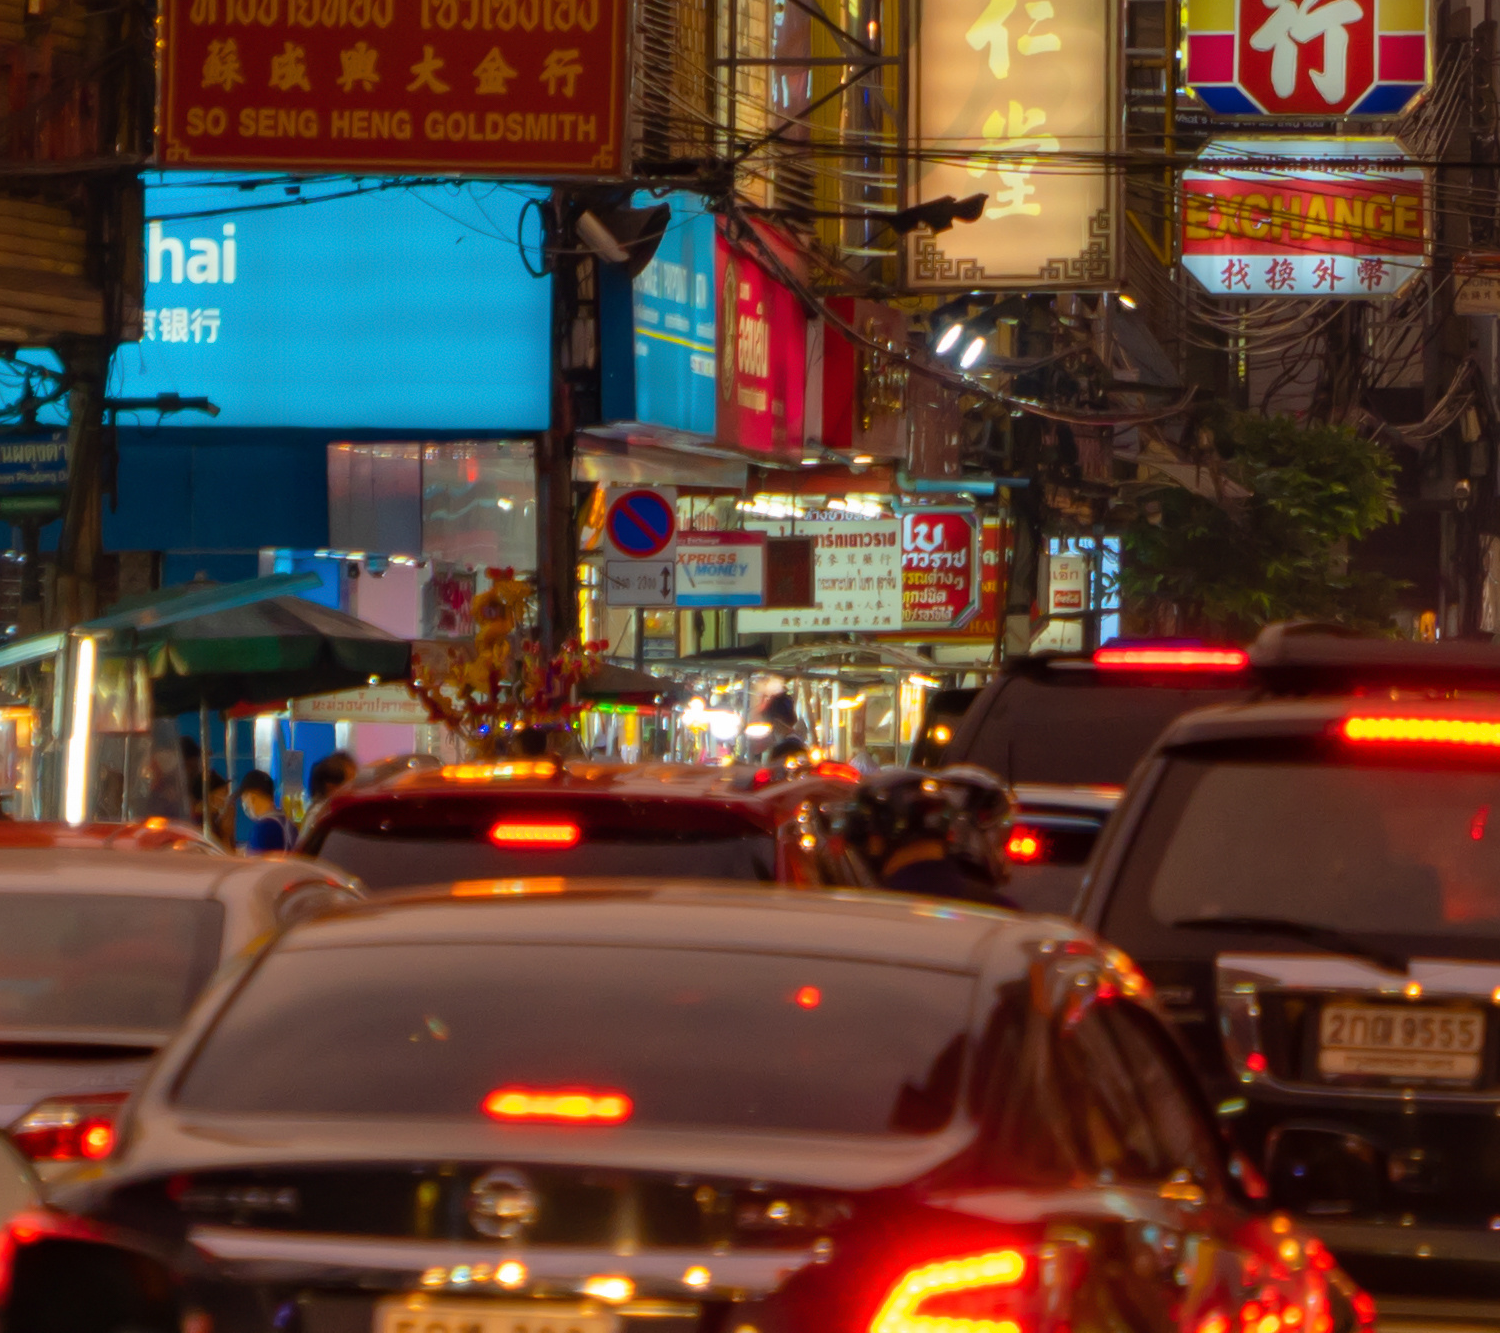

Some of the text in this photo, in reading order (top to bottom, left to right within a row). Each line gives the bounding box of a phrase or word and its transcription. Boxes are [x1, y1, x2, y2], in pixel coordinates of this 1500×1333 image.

[185, 107, 598, 145] SO SENG HENG GOLDSMITH
[1184, 192, 1422, 242] EXCHANGE
[148, 223, 236, 286] hai
[694, 563, 749, 579] MONEY
[1400, 1016, 1476, 1050] 9555
